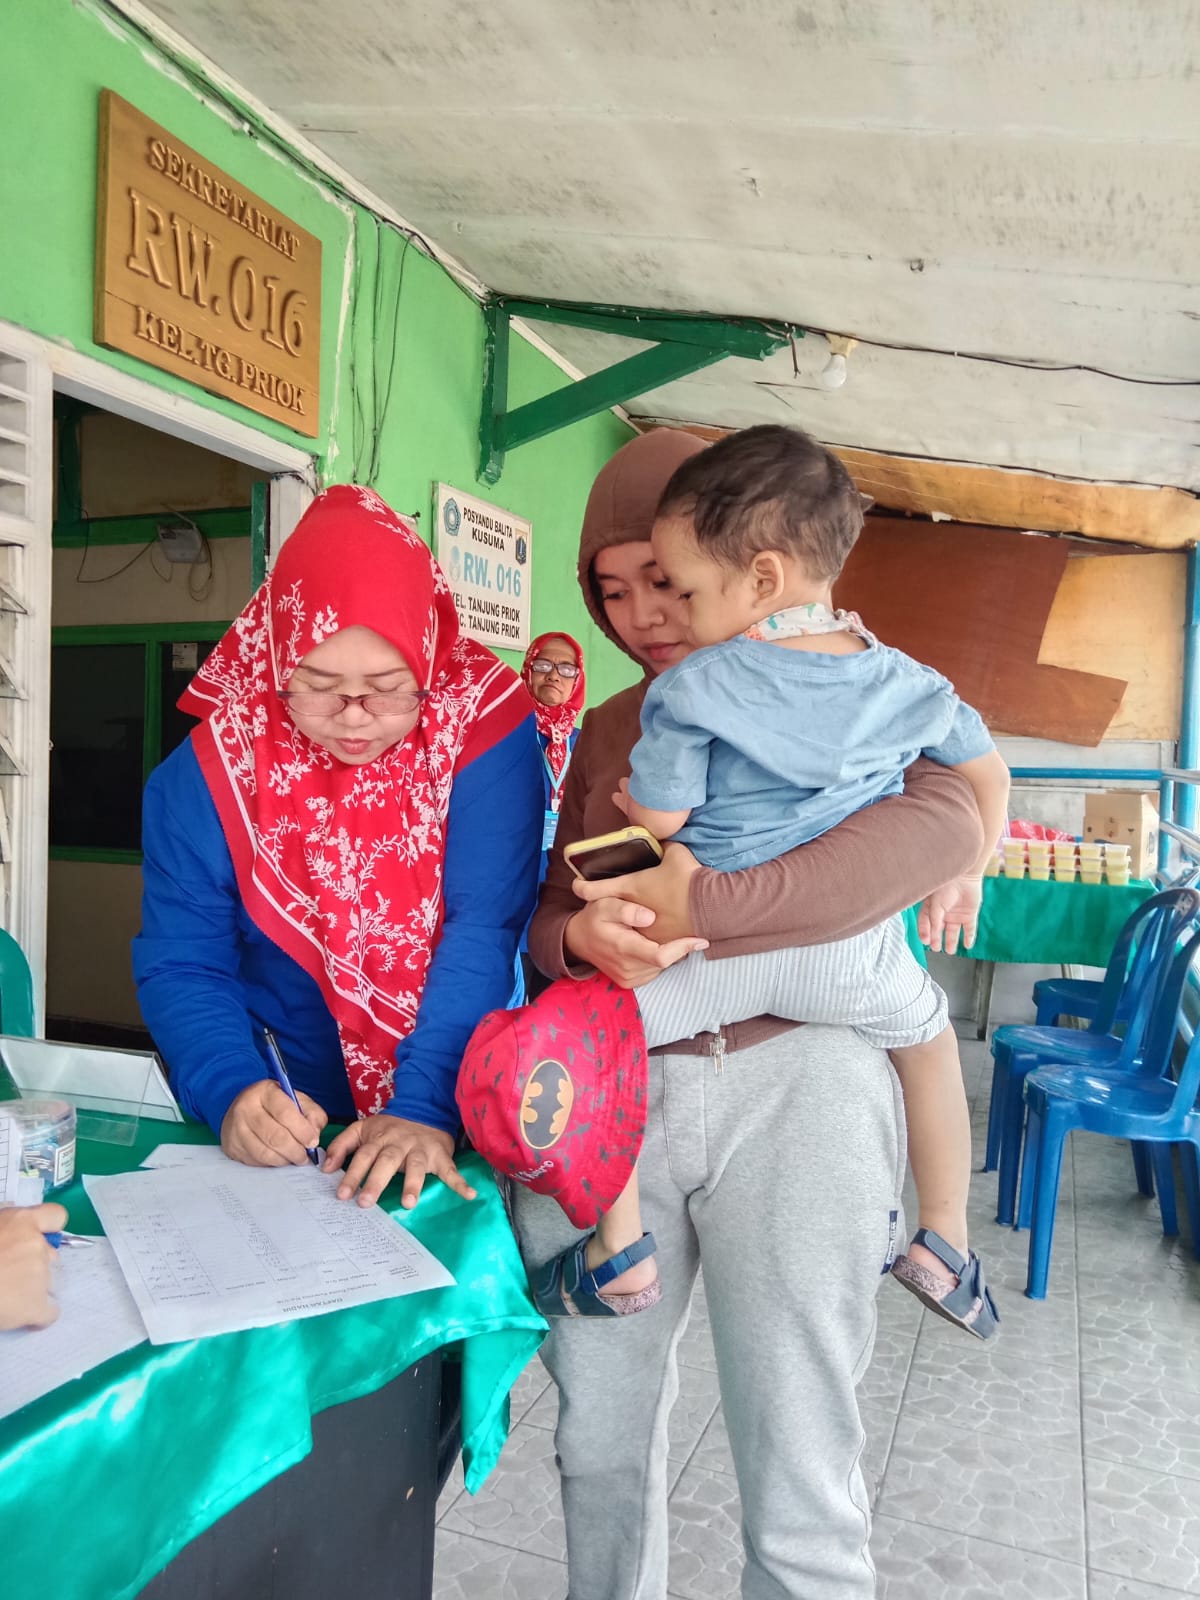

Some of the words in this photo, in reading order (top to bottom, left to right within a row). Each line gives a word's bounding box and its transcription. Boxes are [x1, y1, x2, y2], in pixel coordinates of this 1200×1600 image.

[149, 137, 300, 261] SEKRETARIAT
[463, 507, 494, 531] POSYANDU
[494, 520, 513, 539] BALITA
[472, 527, 505, 551] KUSUMA
[496, 563, 522, 598] 016
[468, 596, 500, 617] TANJUNG
[501, 605, 520, 623] PRIOK
[468, 614, 500, 635] TANJUNG
[501, 622, 520, 640] PRIOK
